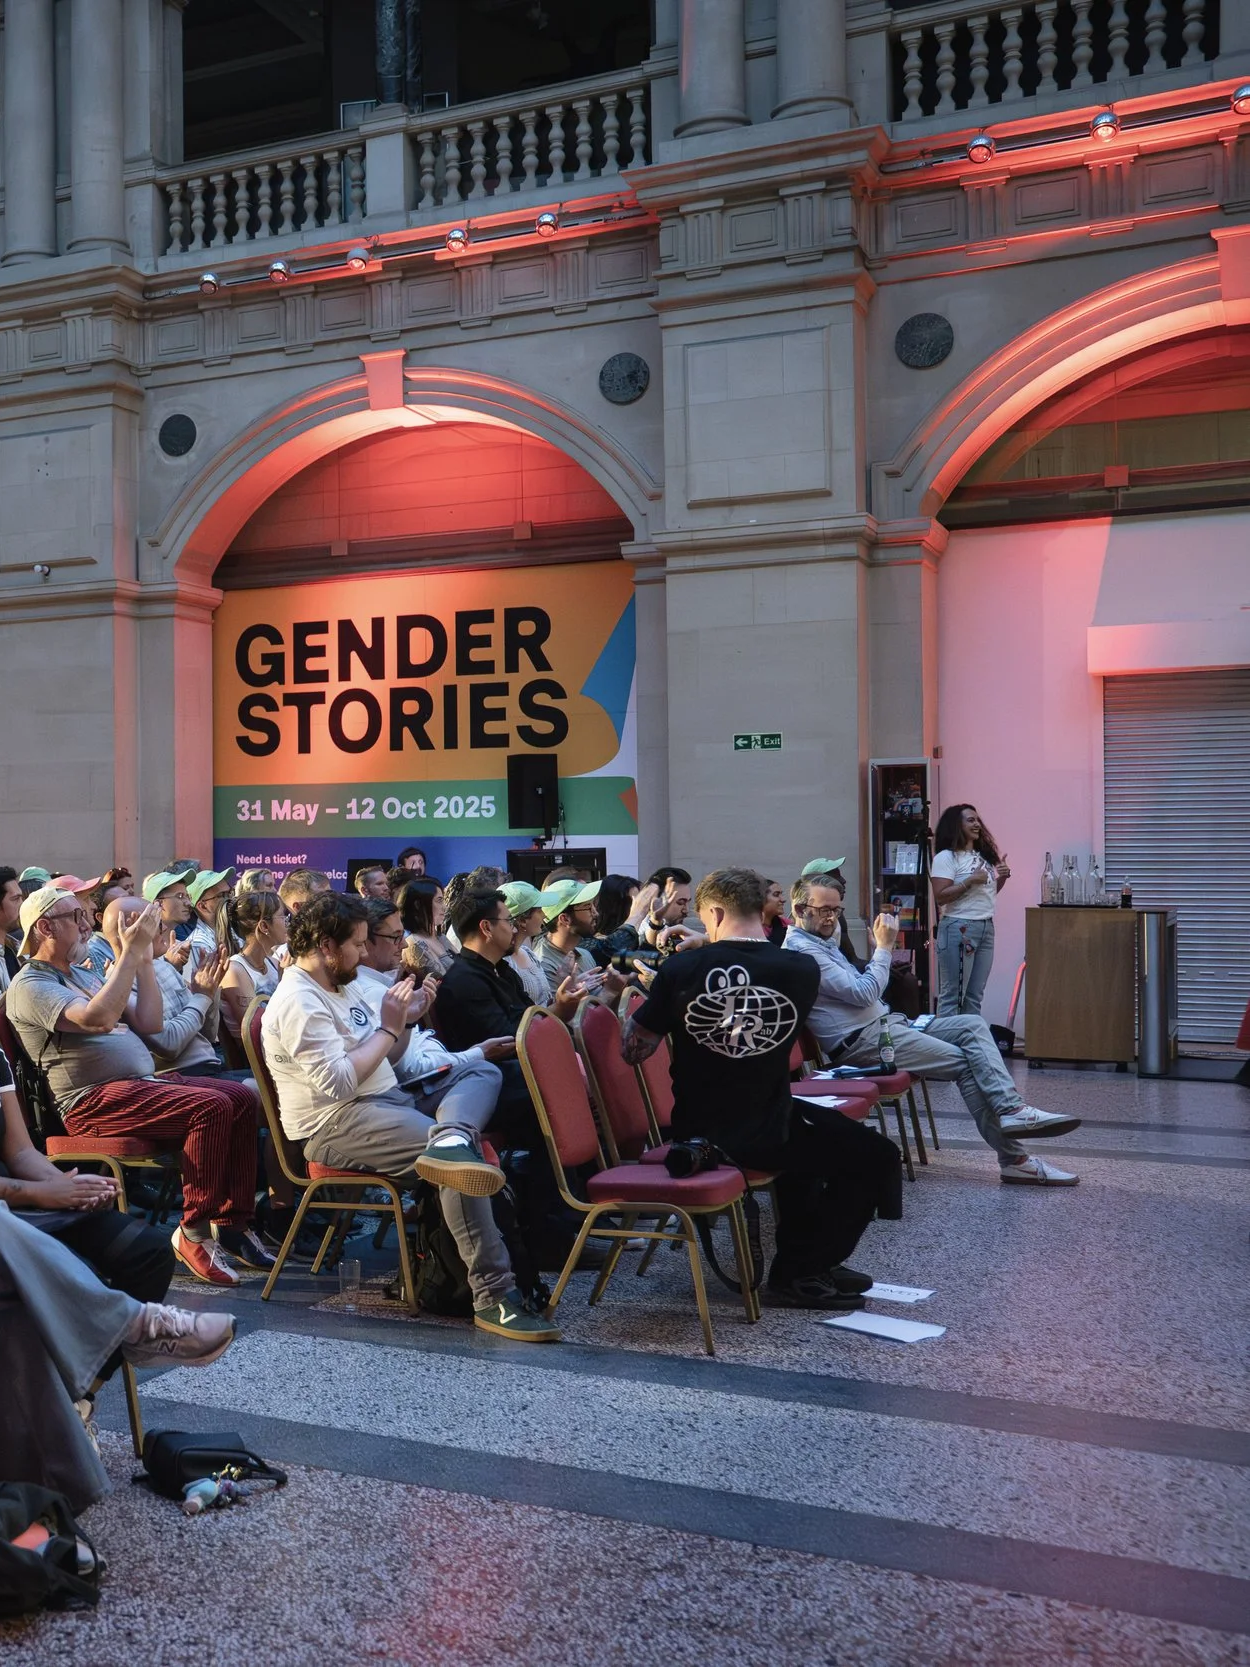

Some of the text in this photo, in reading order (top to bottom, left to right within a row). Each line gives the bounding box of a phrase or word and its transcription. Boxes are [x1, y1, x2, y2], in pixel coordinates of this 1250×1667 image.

[235, 606, 554, 687] GENDER
[235, 678, 569, 757] STORIES
[763, 737, 781, 746] Exit
[236, 799, 264, 822] 31
[271, 799, 319, 826] May
[346, 798, 375, 820] 12
[382, 796, 427, 819] Oct
[433, 795, 496, 819] 2025
[236, 853, 307, 865] Need a ticket?
